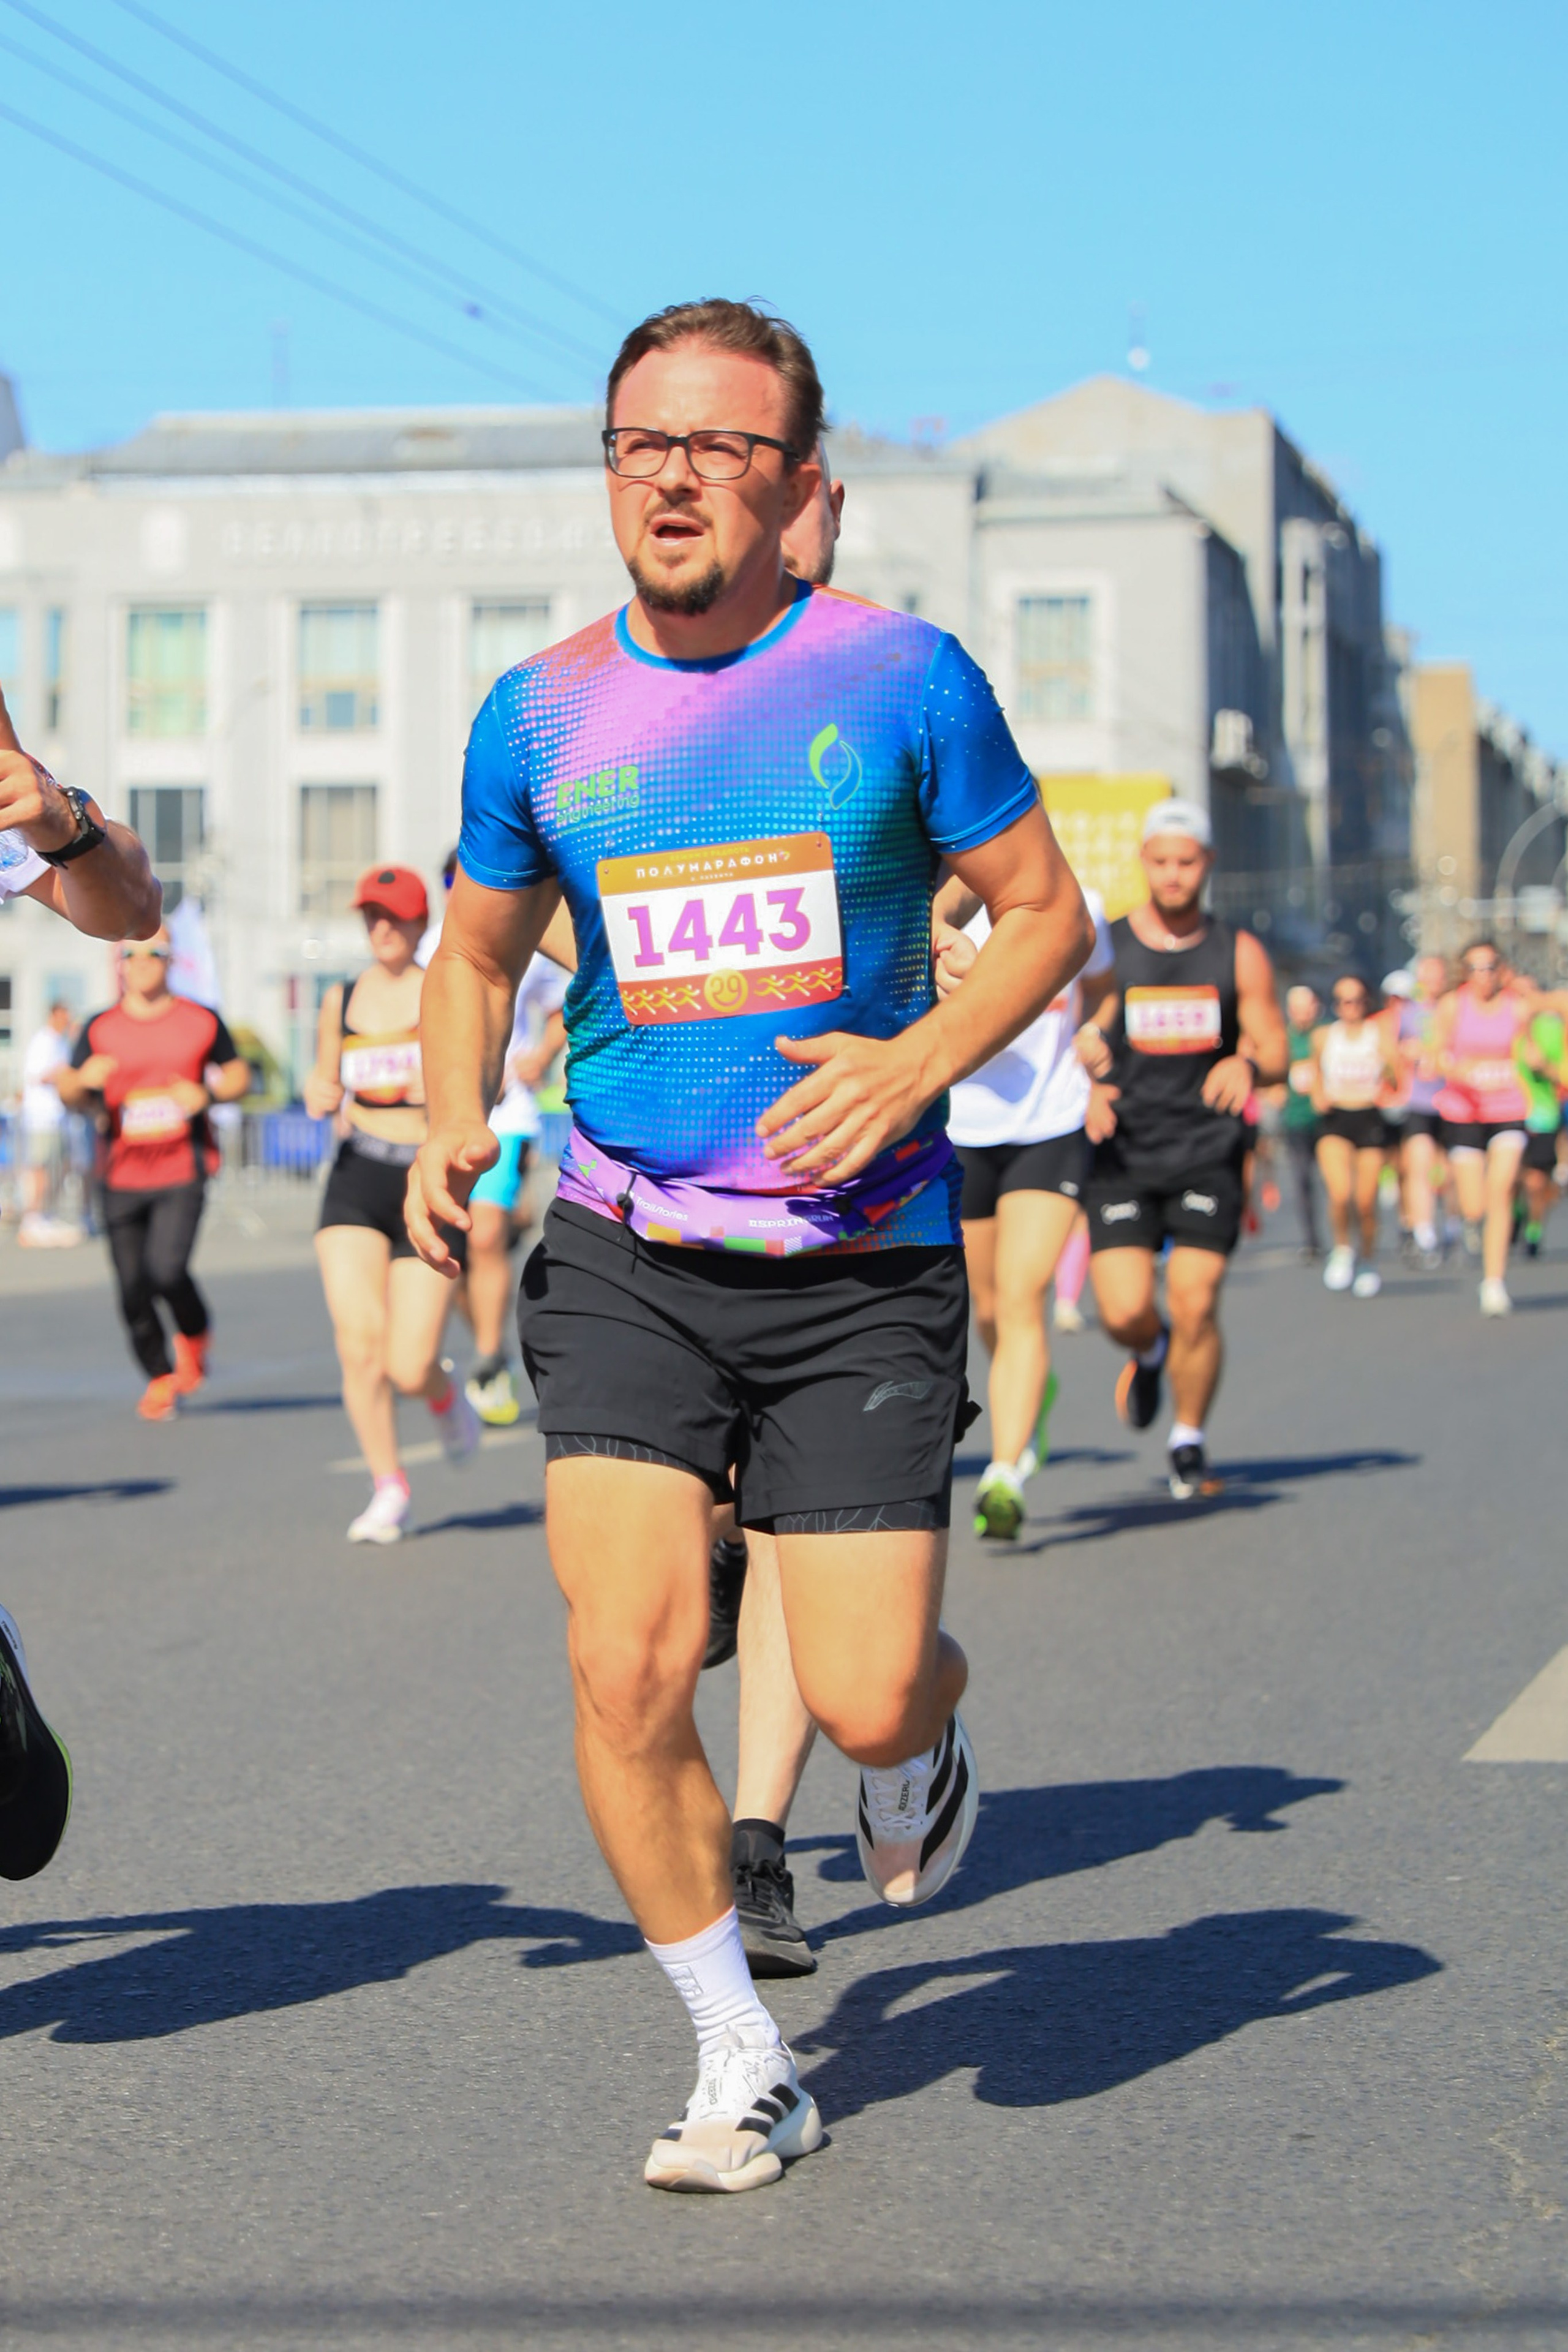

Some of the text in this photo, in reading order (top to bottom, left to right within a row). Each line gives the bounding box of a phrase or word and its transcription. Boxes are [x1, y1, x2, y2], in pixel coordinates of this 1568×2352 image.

[556, 765, 639, 810] ENER
[636, 852, 777, 878] ПОЛУМАРАФОН
[627, 887, 811, 968] 1443
